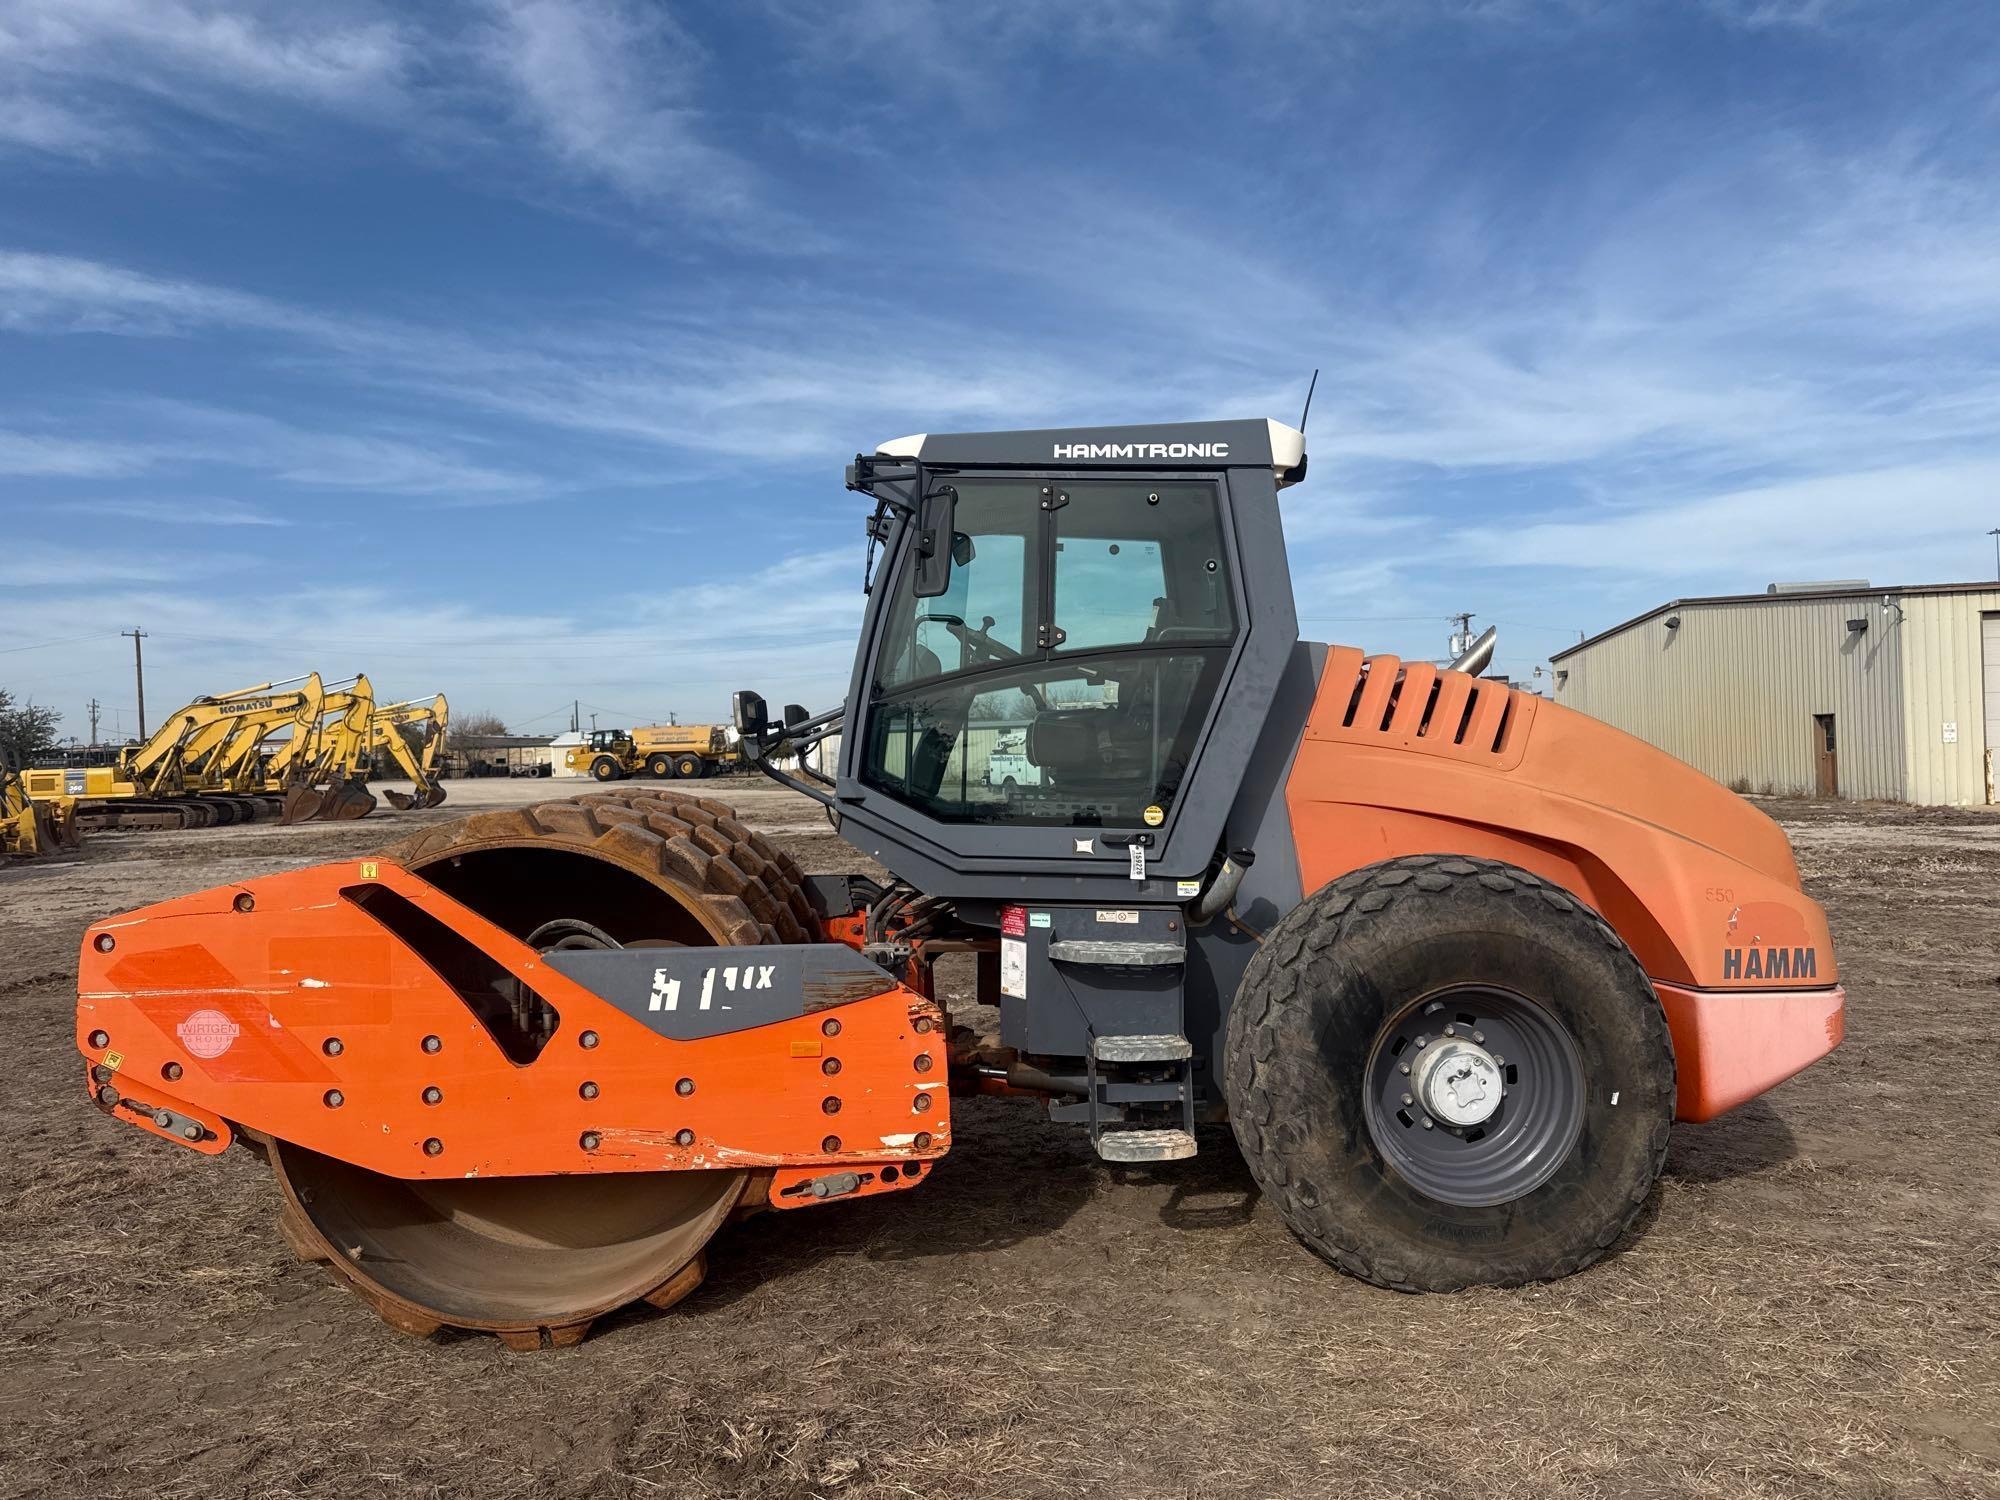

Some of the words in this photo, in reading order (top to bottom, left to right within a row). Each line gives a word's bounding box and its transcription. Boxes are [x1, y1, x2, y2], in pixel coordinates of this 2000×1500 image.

[1053, 443, 1229, 459] HAMMTRONIC
[219, 700, 273, 714] KOMATSU
[1723, 947, 1817, 979] HAMM
[181, 1023, 237, 1034] WIRTGEN
[185, 1035, 233, 1043] GROUP
